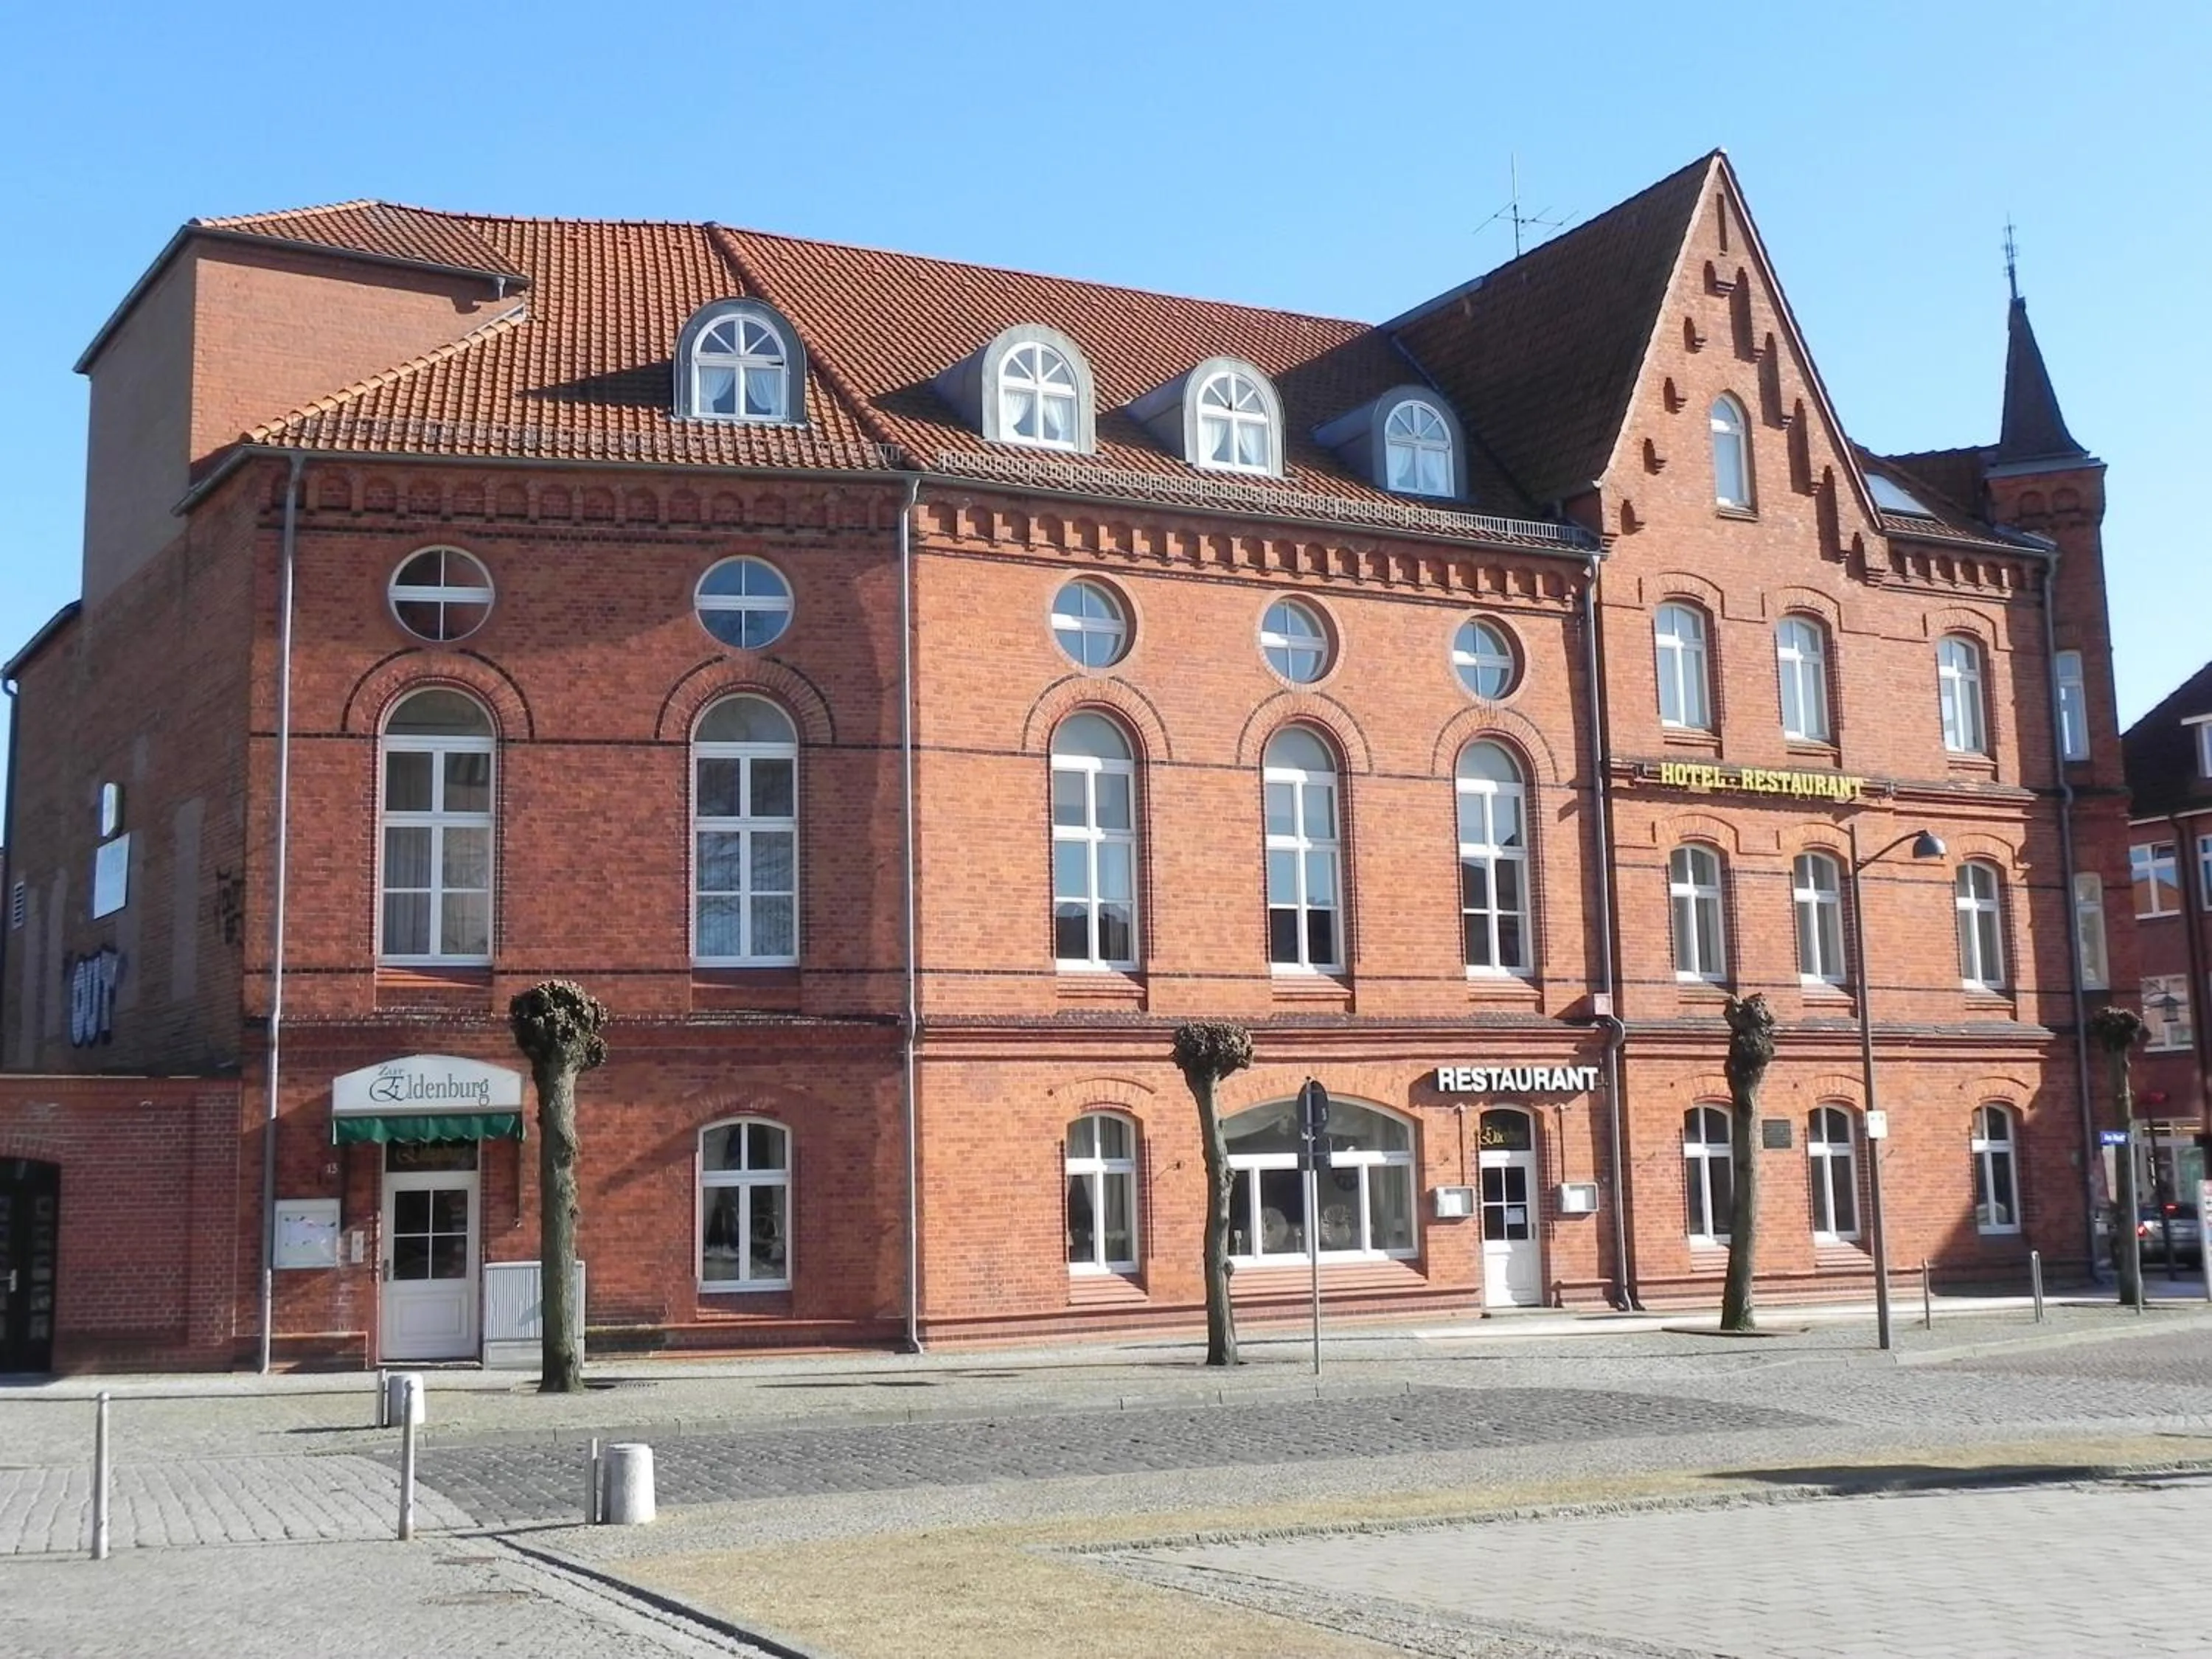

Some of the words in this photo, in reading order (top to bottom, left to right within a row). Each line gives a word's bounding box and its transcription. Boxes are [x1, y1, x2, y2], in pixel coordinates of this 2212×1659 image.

[1660, 762, 1726, 788] HOTEL
[1741, 768, 1865, 799] RESTAURANT
[378, 1065, 406, 1076] Zur
[1437, 1066, 1599, 1093] RESTAURANT
